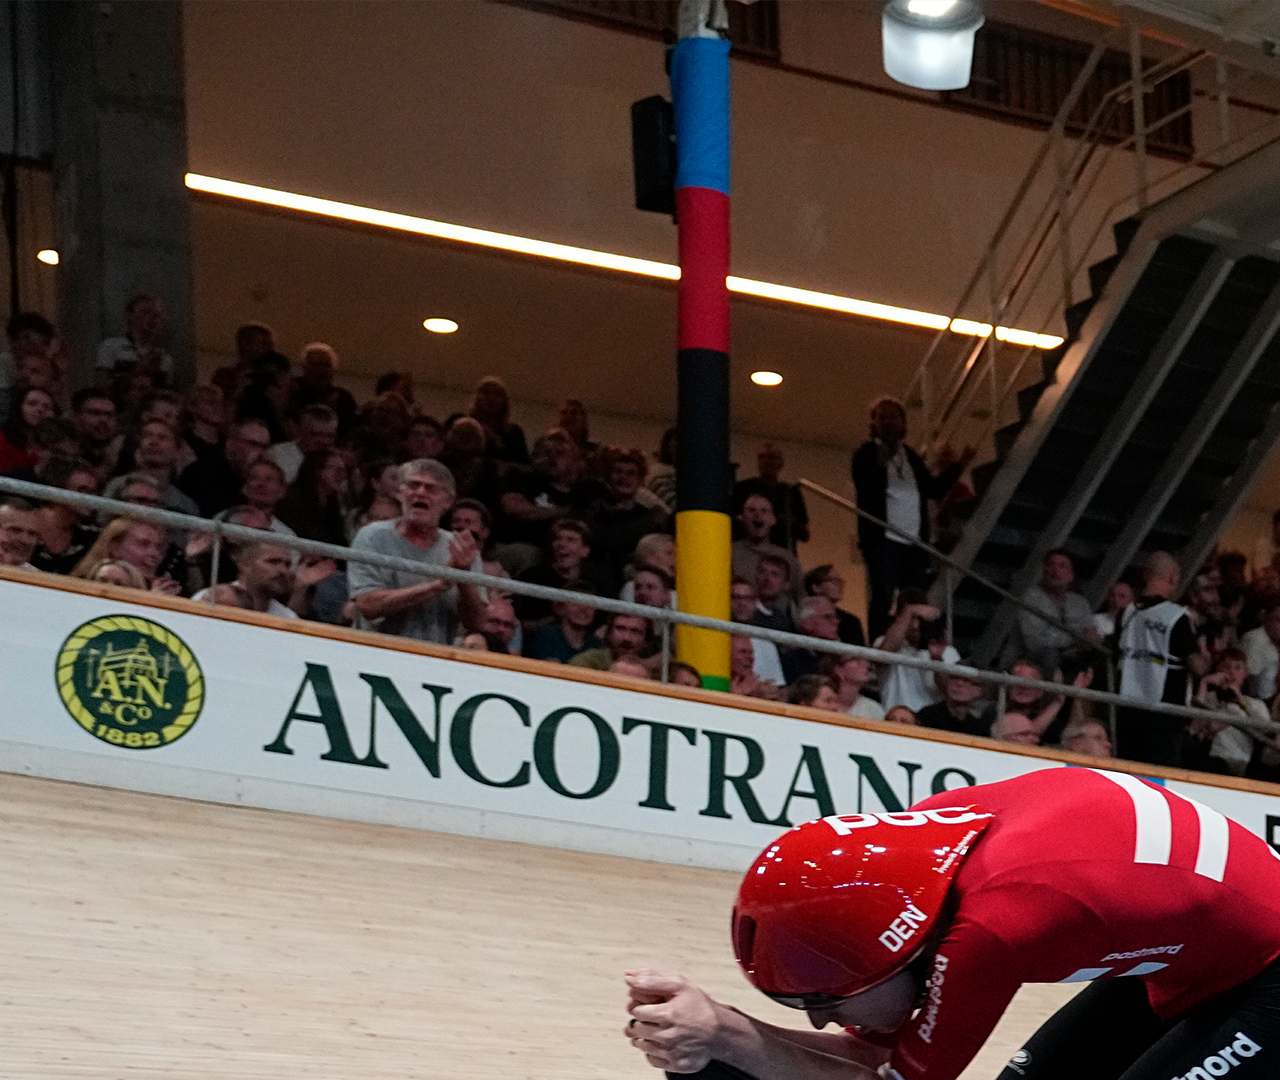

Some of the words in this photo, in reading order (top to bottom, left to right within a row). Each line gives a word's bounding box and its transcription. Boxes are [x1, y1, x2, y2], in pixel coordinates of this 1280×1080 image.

[96, 724, 161, 748] 1882
[878, 904, 928, 952] DEN
[1100, 943, 1185, 962] postnord
